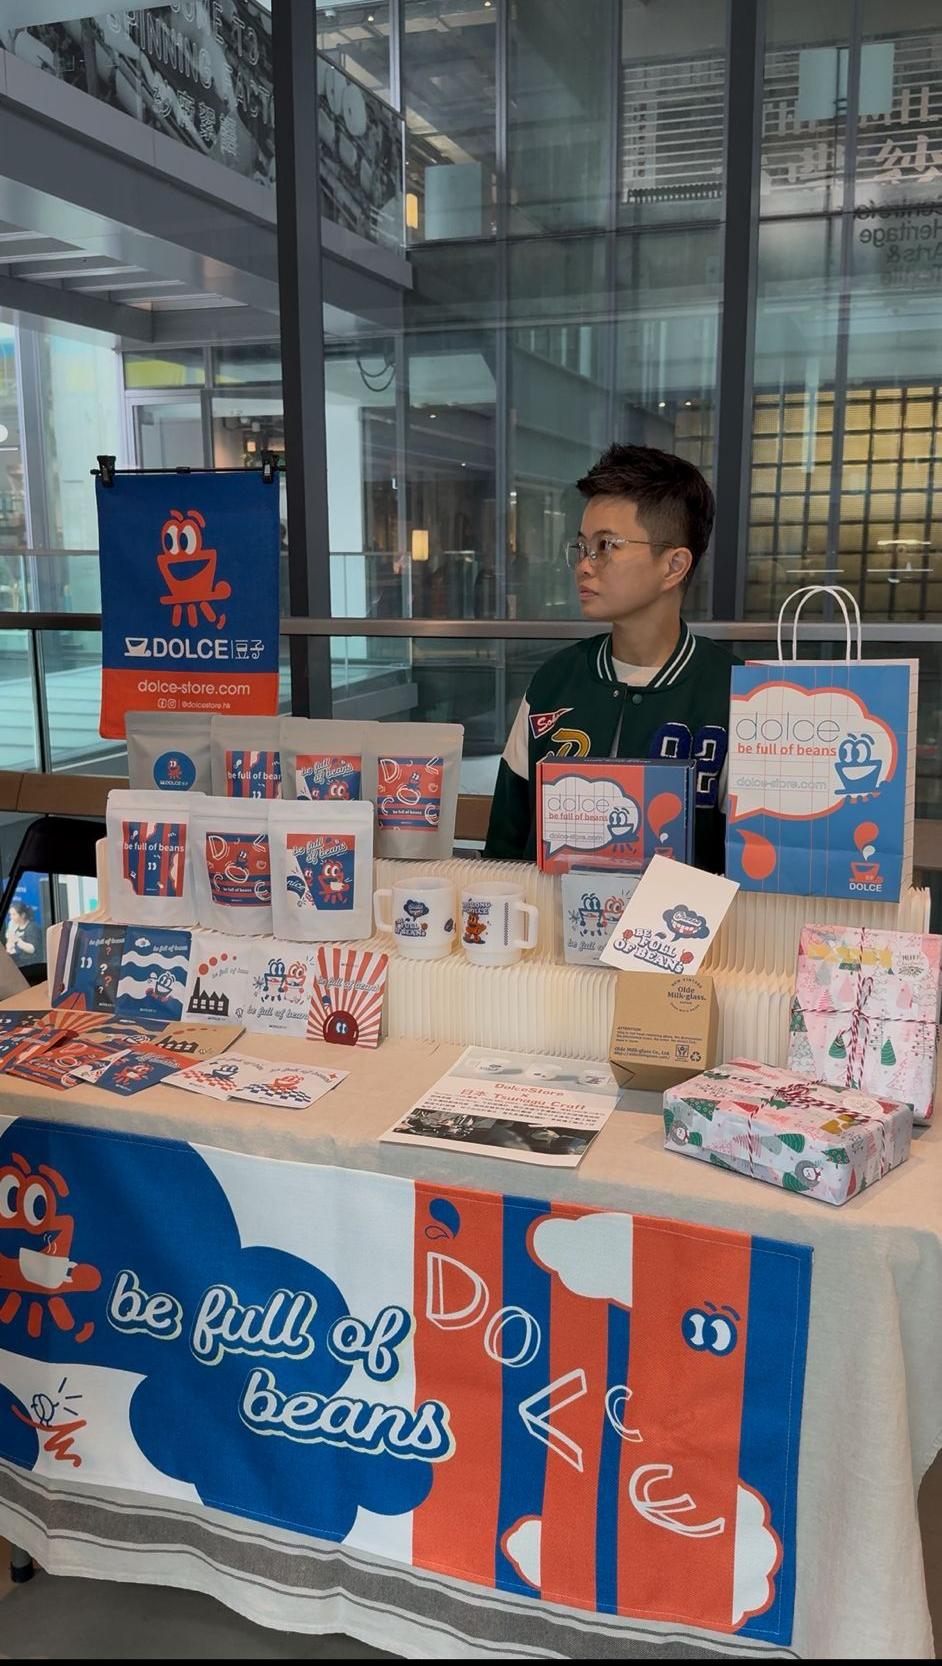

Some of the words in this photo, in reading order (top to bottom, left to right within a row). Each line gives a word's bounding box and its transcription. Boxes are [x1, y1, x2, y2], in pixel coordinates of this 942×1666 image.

[153, 638, 229, 659] DOLCE
[137, 679, 250, 696] dolce-store.com
[735, 711, 841, 743] dolce
[737, 742, 752, 755] be
[756, 743, 777, 755] full
[780, 744, 795, 756] of
[796, 745, 837, 757] beans
[227, 771, 237, 780] be
[237, 771, 251, 780] full
[252, 771, 262, 780] of
[736, 776, 828, 791] dolce-store.com
[547, 794, 610, 813] dolce
[548, 812, 559, 821] be
[560, 812, 574, 821] full
[574, 812, 584, 821] of
[584, 813, 609, 822] beans
[123, 842, 134, 850] be
[134, 842, 148, 851] full
[148, 843, 158, 851] of
[158, 843, 185, 852] beans
[319, 841, 348, 860] beans
[849, 882, 883, 892] DOLCE
[634, 927, 652, 939] BE
[578, 940, 596, 952] full
[613, 939, 636, 955] OF
[638, 936, 677, 958] FULL
[327, 976, 343, 990] full
[677, 985, 695, 993] Olde
[257, 1006, 273, 1018] full
[274, 1008, 286, 1020] of
[494, 1083, 565, 1097] DolceStore
[459, 1088, 486, 1097] 日本
[494, 1093, 546, 1106] Tsunagu
[551, 1101, 587, 1111] Craft
[107, 1269, 184, 1340] be
[190, 1283, 318, 1366] full
[327, 1305, 416, 1382] of
[239, 1367, 456, 1463] beans
